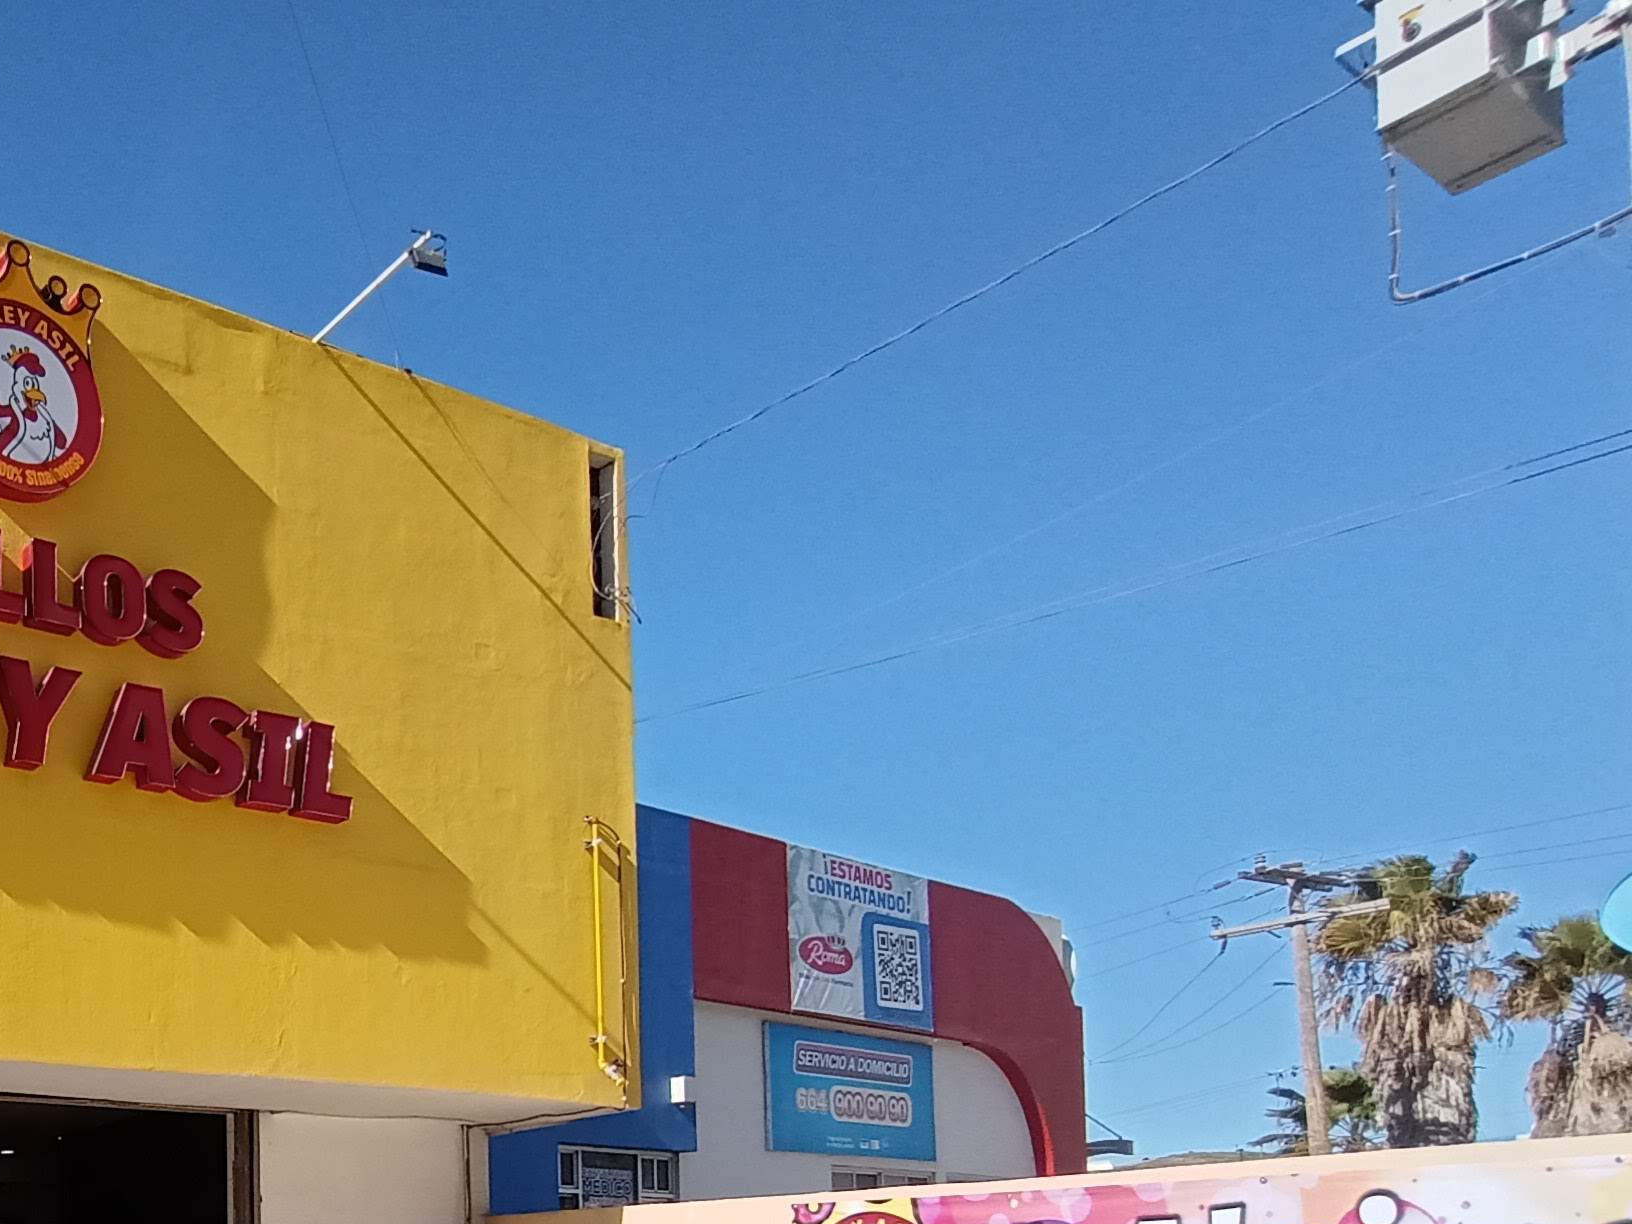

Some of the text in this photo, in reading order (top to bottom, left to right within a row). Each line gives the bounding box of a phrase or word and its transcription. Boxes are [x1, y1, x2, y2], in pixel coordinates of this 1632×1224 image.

[35, 320, 82, 372] ASIL
[84, 682, 353, 824] ASIL
[822, 853, 893, 891] ¡ESTAMOS
[807, 874, 911, 914] CONTRATANDO!
[808, 941, 846, 966] Roma
[797, 1050, 909, 1078] SERVICIO A DOMICILIO
[833, 1090, 865, 1120] 900
[866, 1094, 886, 1121] 90
[888, 1096, 908, 1122] 90
